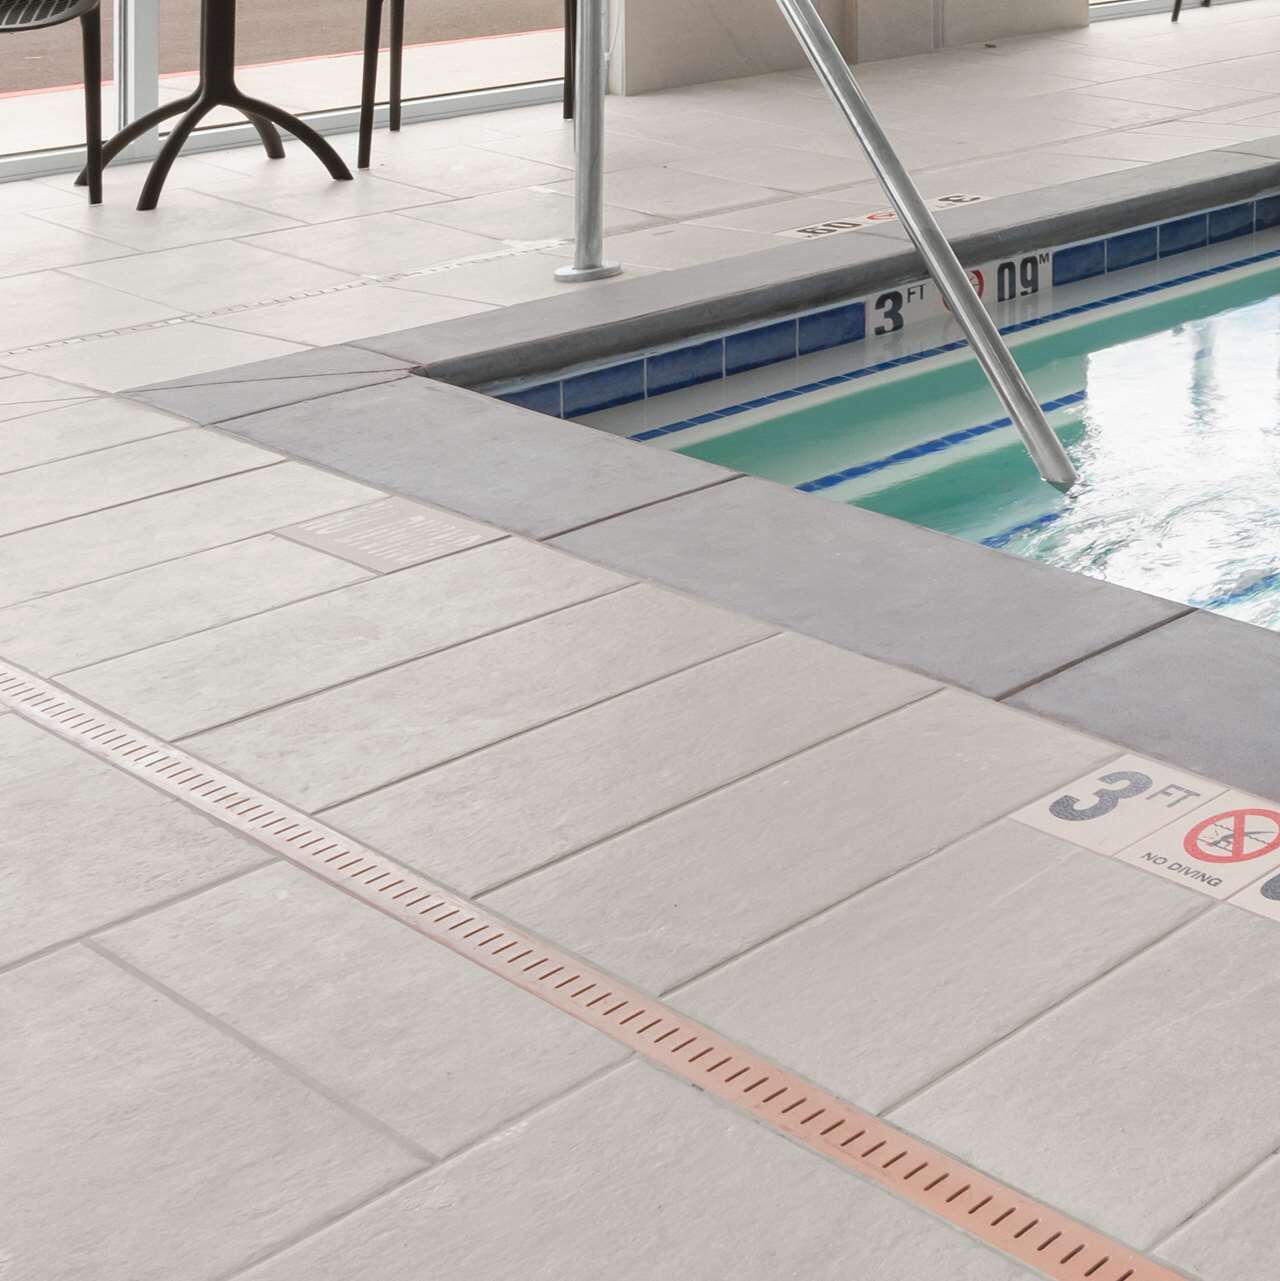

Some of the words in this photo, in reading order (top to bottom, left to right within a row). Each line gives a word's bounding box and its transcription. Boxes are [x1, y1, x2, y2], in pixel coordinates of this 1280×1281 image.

[875, 291, 904, 336] 3
[907, 284, 926, 303] FT
[1039, 253, 1049, 265] M
[1048, 770, 1153, 822] 3
[1145, 783, 1201, 809] FT
[1141, 851, 1168, 866] NO
[1168, 861, 1223, 888] DIVING
